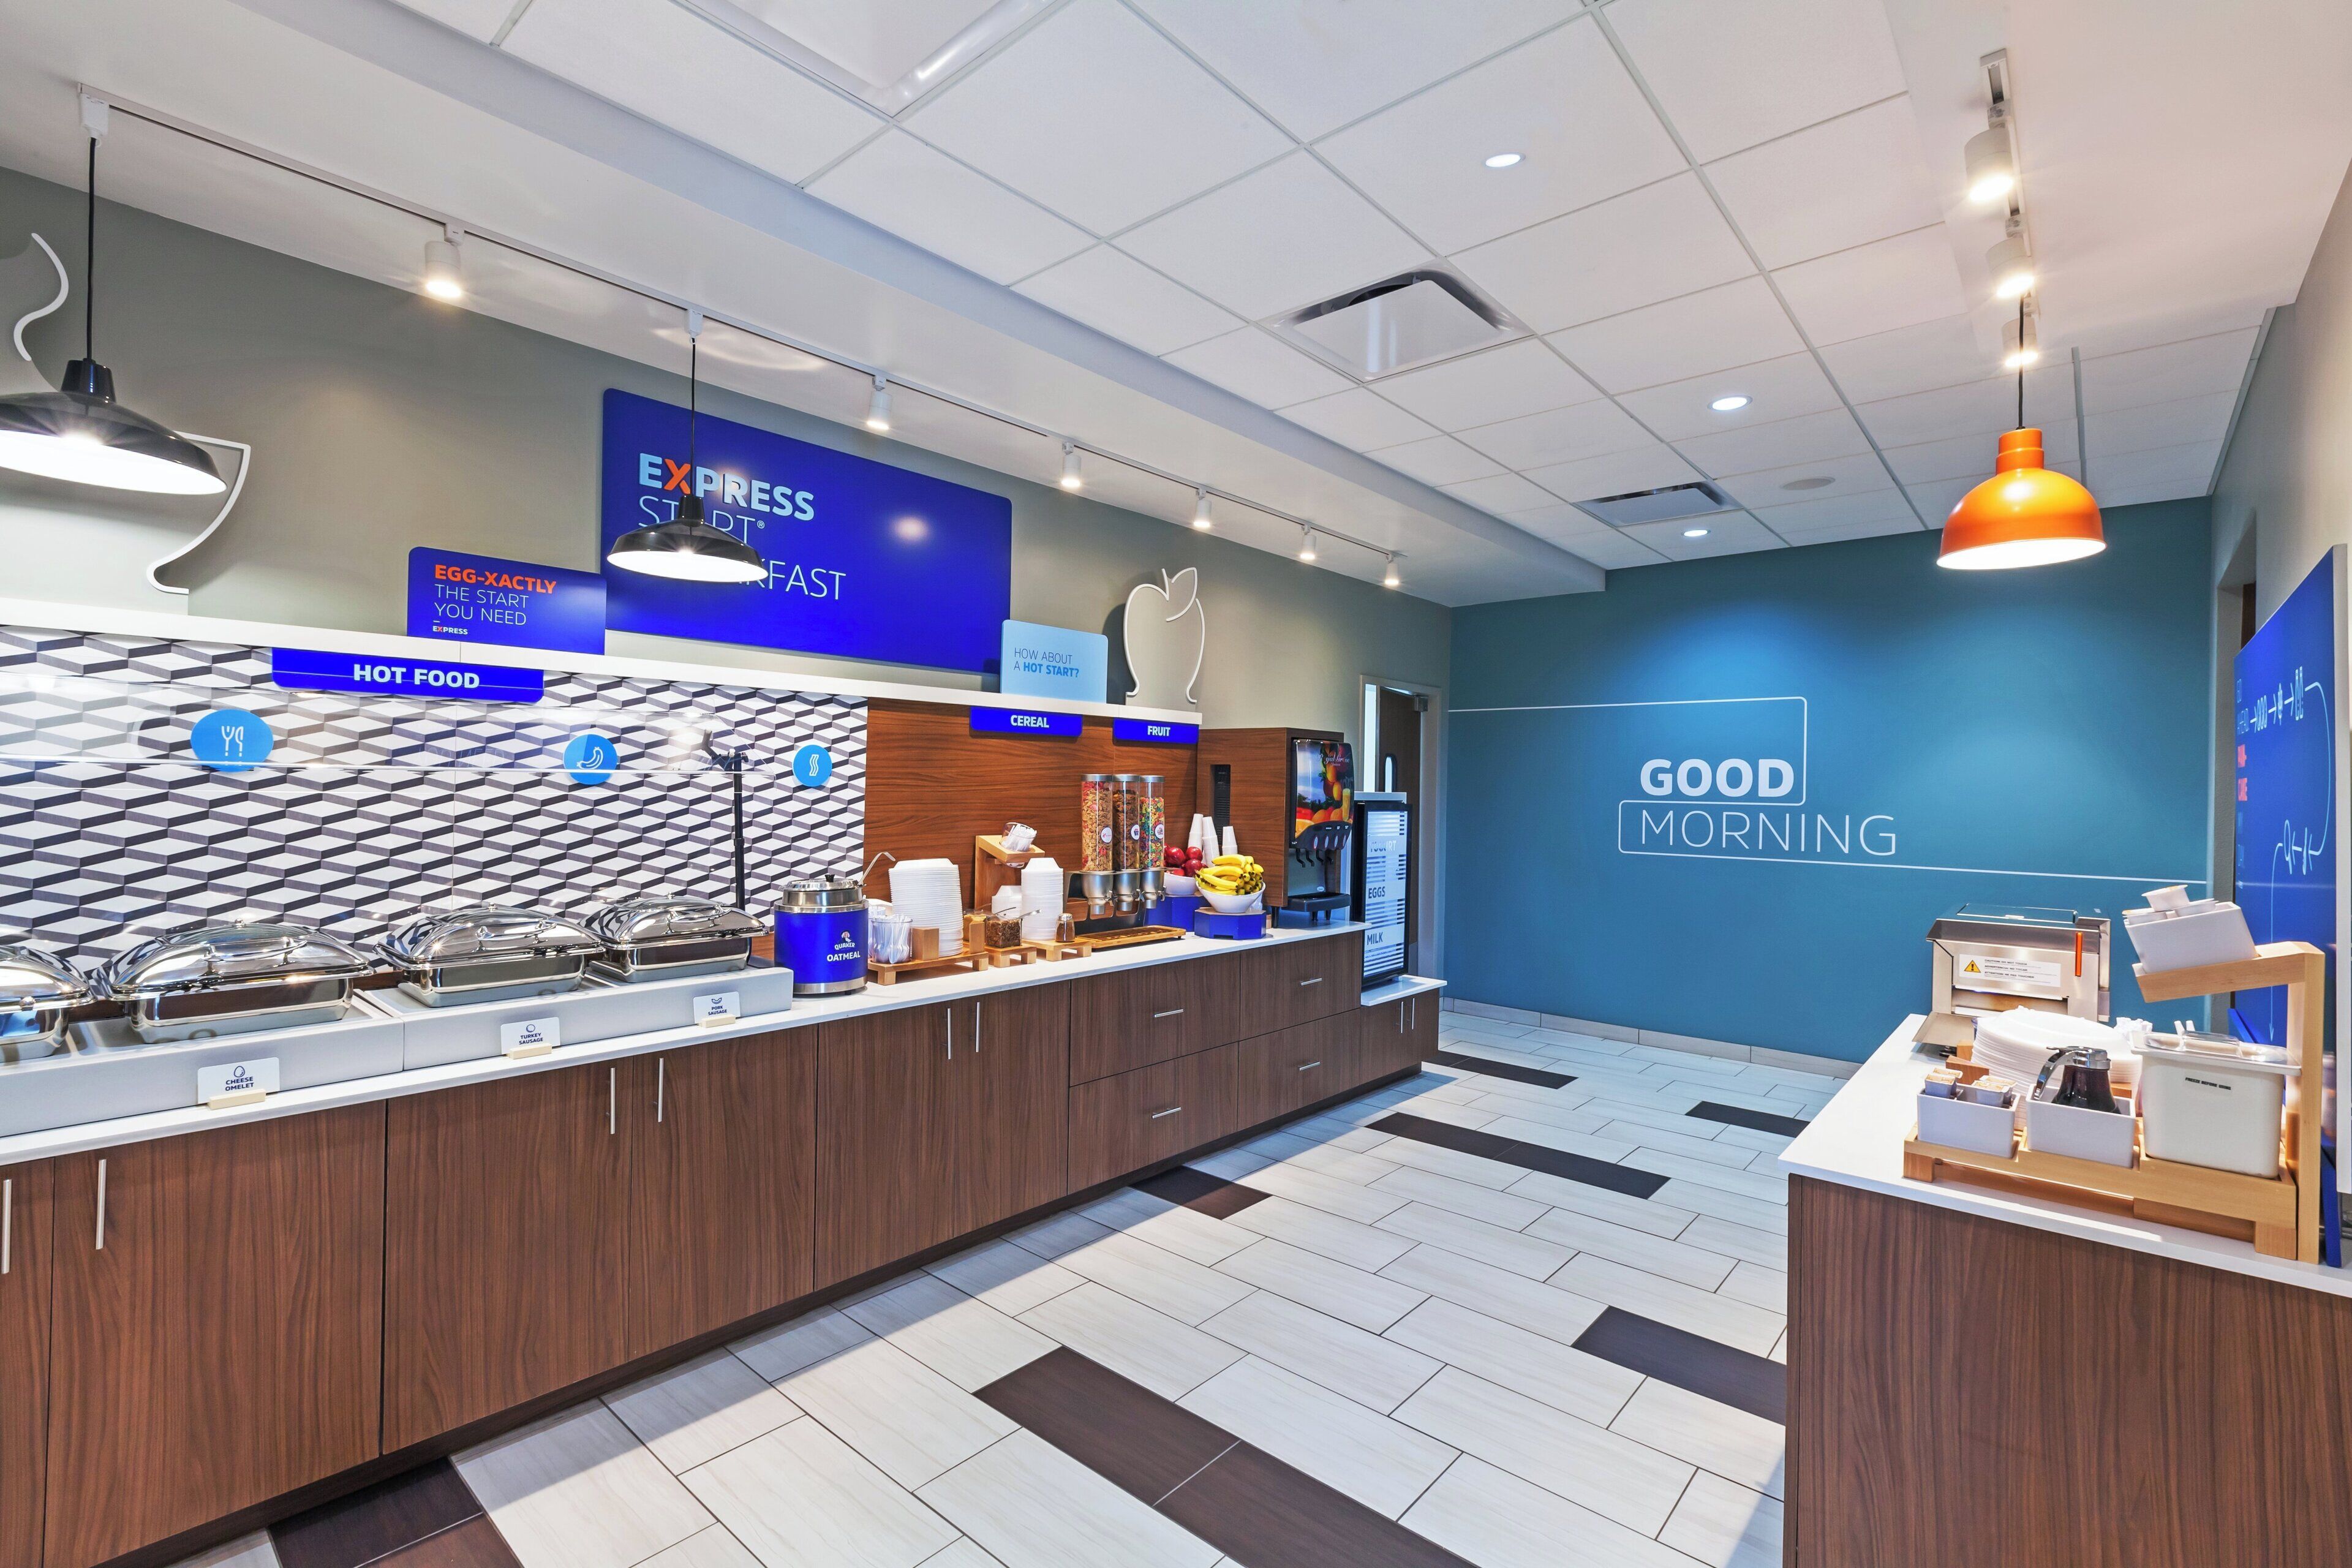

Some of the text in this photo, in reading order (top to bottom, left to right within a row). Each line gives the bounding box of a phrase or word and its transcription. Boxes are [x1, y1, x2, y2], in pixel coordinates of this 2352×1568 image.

[638, 452, 815, 521] EXPRESS
[434, 564, 557, 594] EGG-XACTLY
[434, 584, 529, 608] THE START
[434, 601, 527, 625] YOU NEED
[432, 625, 469, 635] EXPRESS
[1014, 647, 1073, 665] HOW ABOUT
[353, 663, 480, 688] HOT FOOD
[1013, 661, 1080, 678] A HOT START?
[1010, 714, 1050, 728] CEREAL
[1147, 725, 1171, 737] FRUIT
[1640, 758, 1795, 797] GOOD
[1642, 809, 1896, 856] MORNING
[1368, 886, 1385, 899] EGGS
[1366, 932, 1383, 946] MILK
[826, 951, 861, 962] OATMEAL
[225, 1076, 254, 1085] CHEESE
[225, 1082, 255, 1091] OMELET
